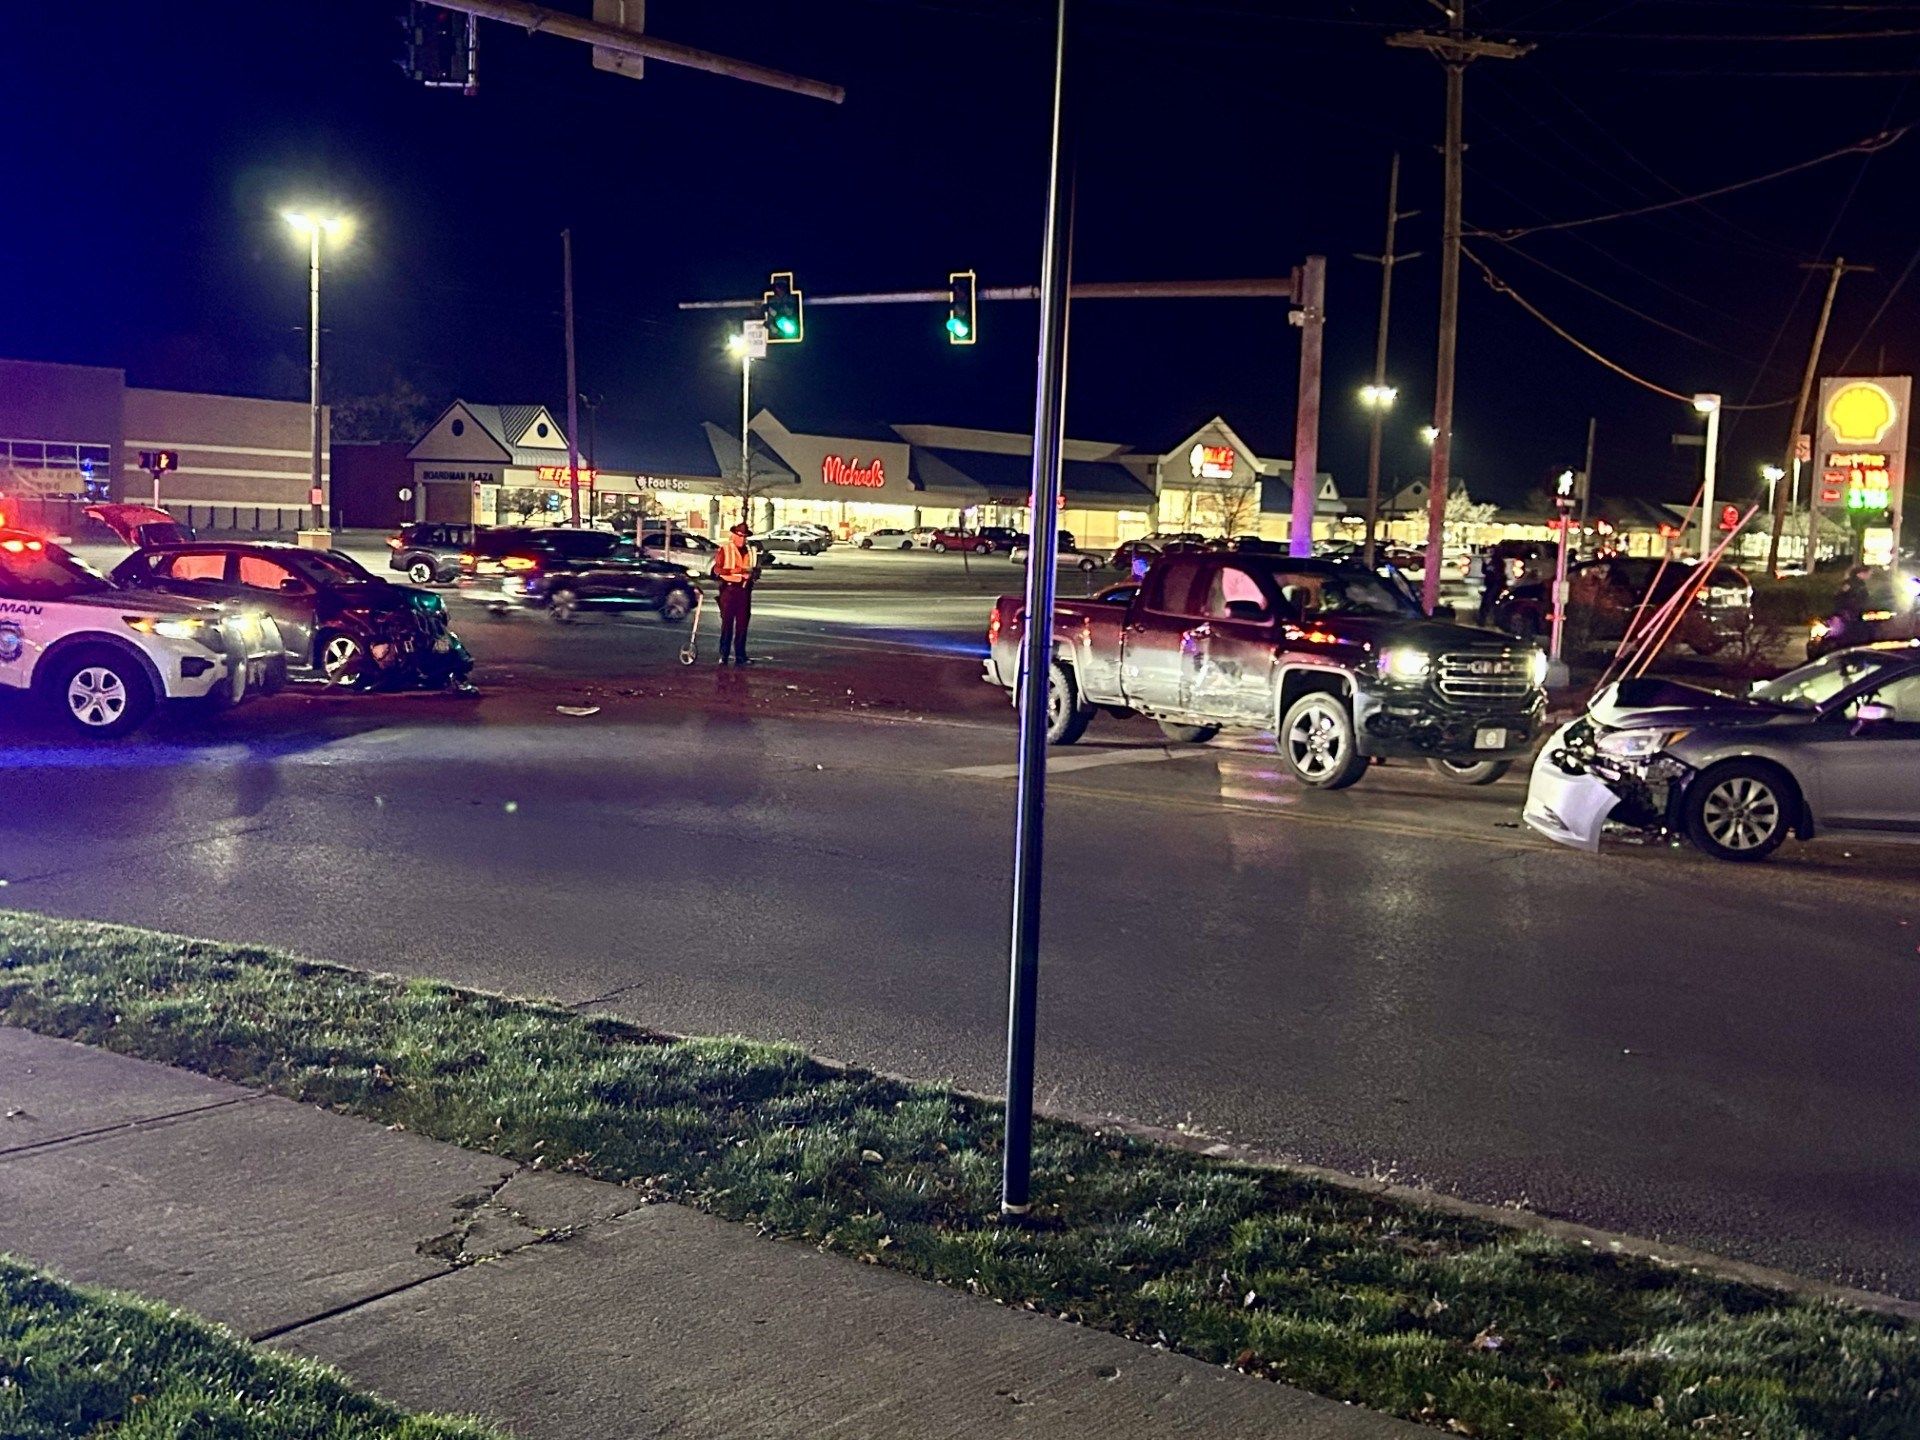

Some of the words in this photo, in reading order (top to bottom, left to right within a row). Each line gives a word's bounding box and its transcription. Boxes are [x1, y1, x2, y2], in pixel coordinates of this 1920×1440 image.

[423, 471, 466, 480] BOARDMAN
[468, 472, 494, 482] PLAZA
[823, 456, 885, 487] Michaels
[672, 478, 690, 491] Spa
[1470, 660, 1514, 674] GMC
